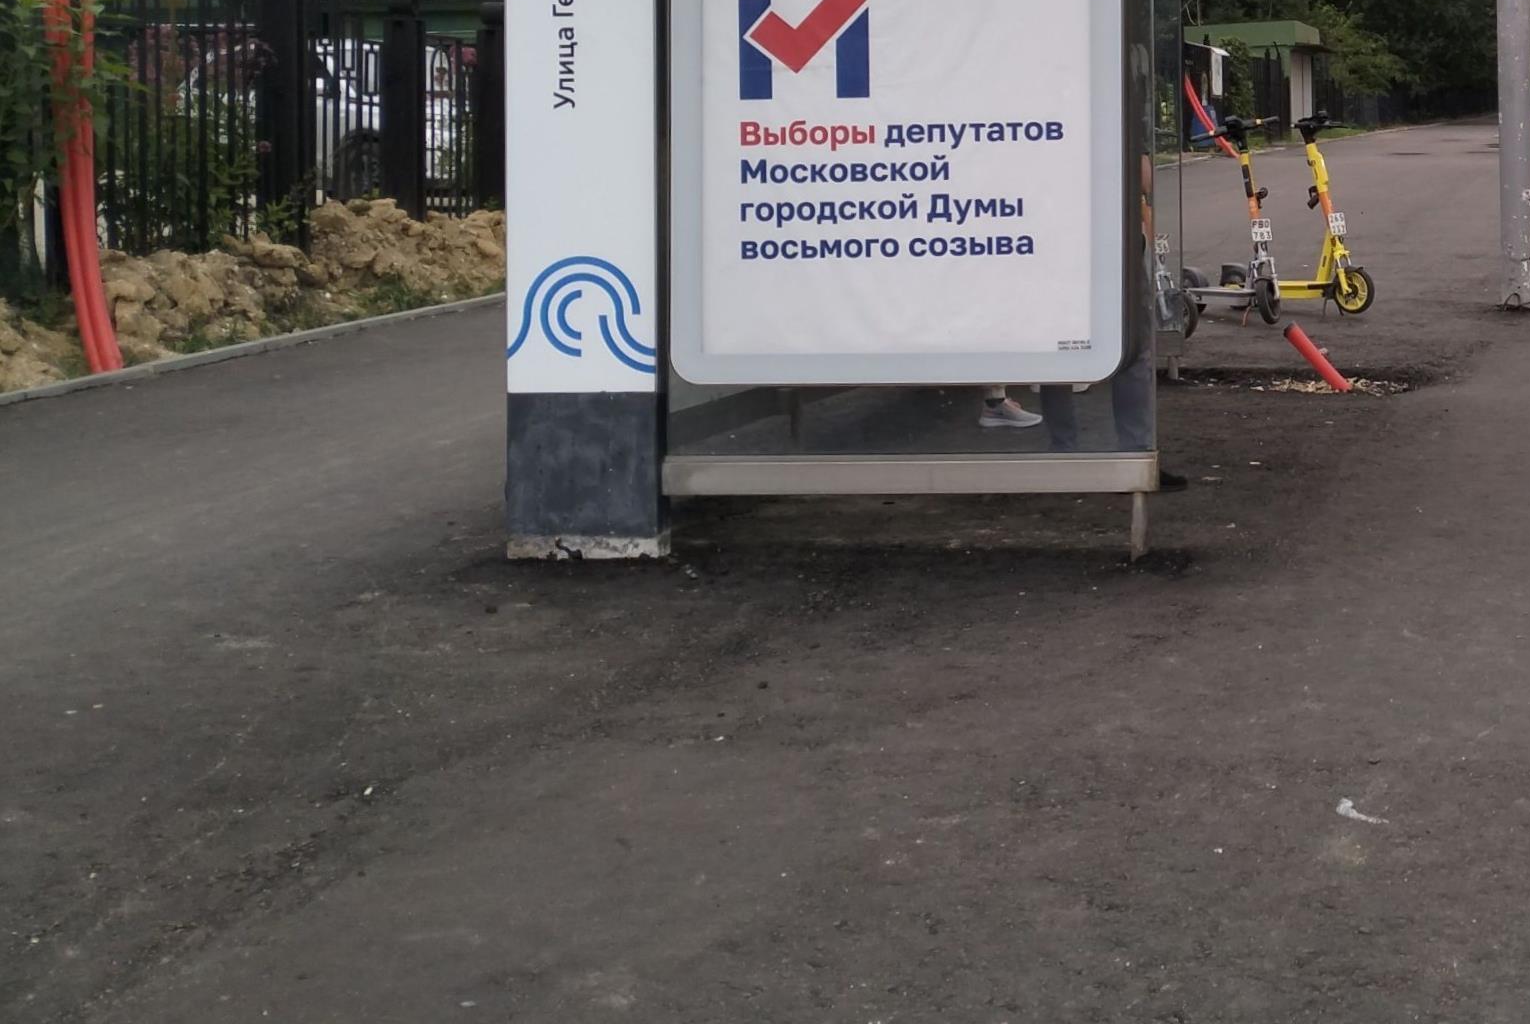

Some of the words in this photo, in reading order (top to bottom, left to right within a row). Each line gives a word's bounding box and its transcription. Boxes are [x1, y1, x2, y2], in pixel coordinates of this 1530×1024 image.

[553, 27, 578, 109] Улица
[740, 120, 875, 152] Выборы
[884, 121, 1064, 150] депутатов
[740, 154, 950, 184] Московской
[740, 192, 918, 229] городской
[926, 193, 1023, 226] Думы
[741, 238, 900, 260] восьмого
[908, 235, 1034, 257] созыва
